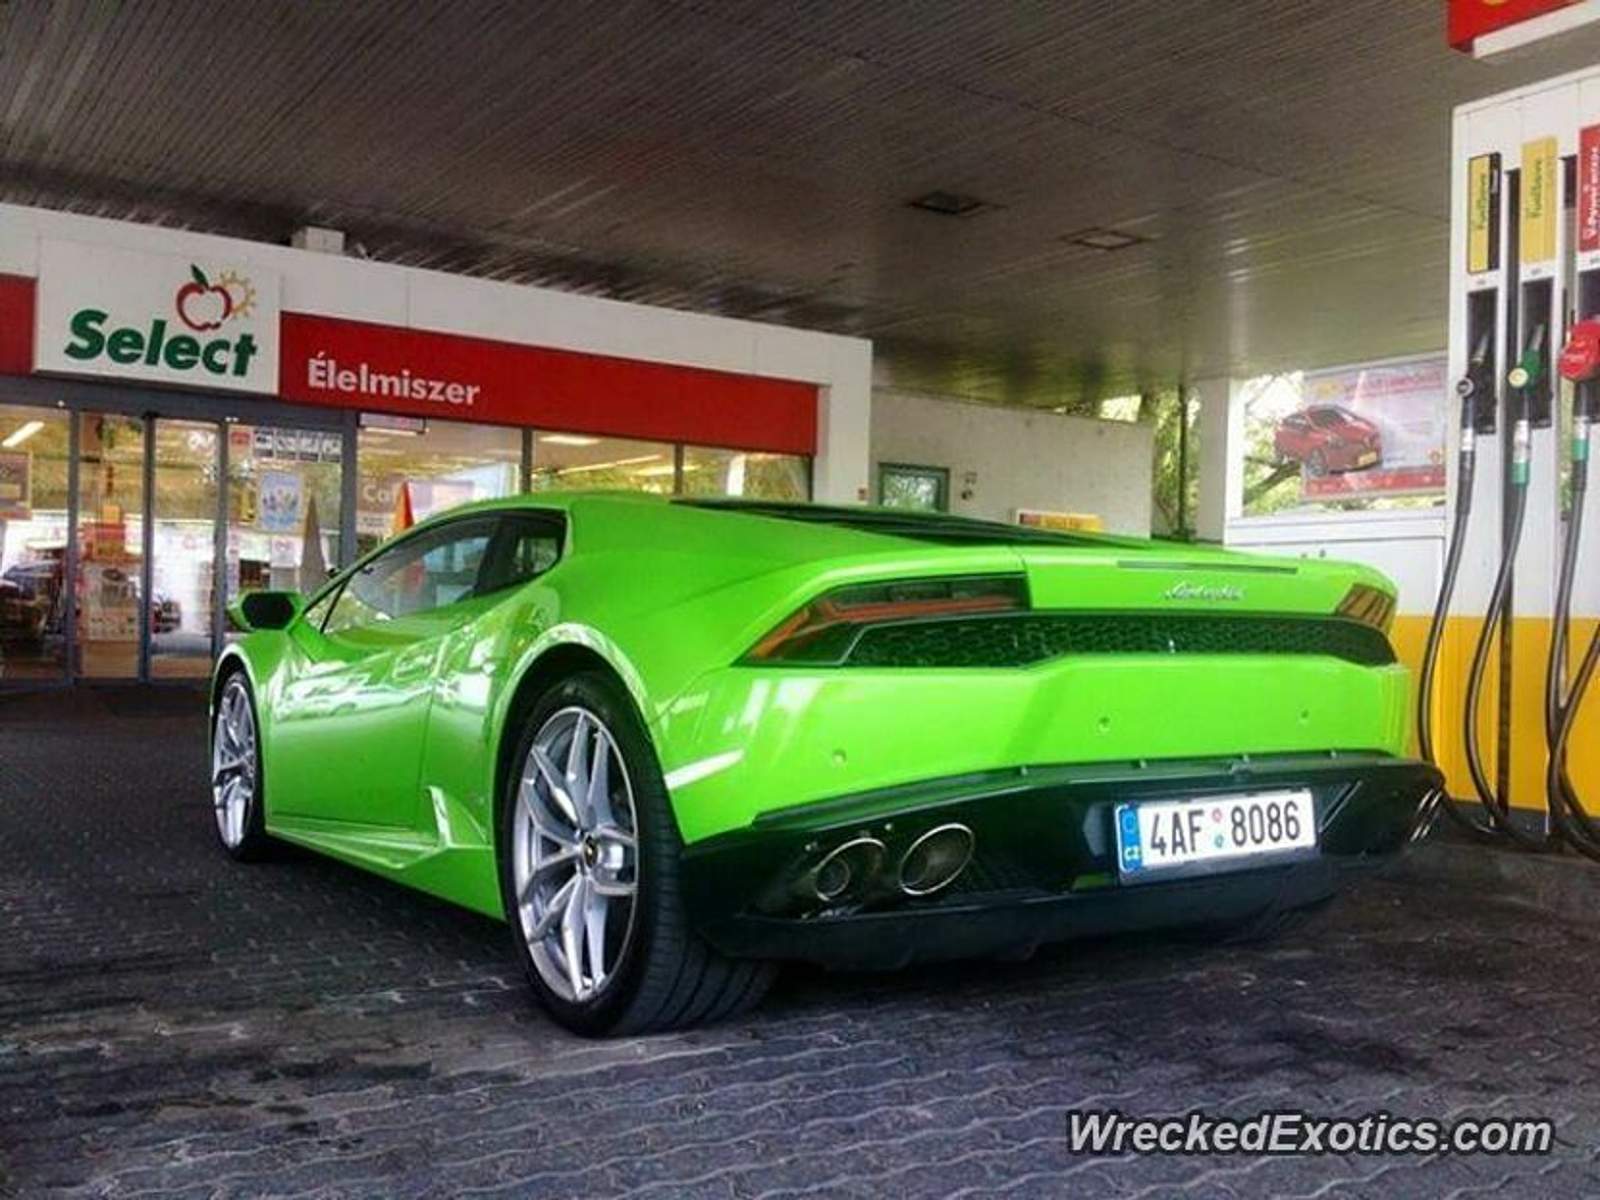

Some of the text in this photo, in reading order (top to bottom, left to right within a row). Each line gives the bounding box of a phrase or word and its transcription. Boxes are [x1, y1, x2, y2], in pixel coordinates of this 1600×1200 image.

[64, 309, 257, 377] Select
[307, 352, 480, 405] Élelmiszer
[1151, 801, 1300, 856] 4AF 8086
